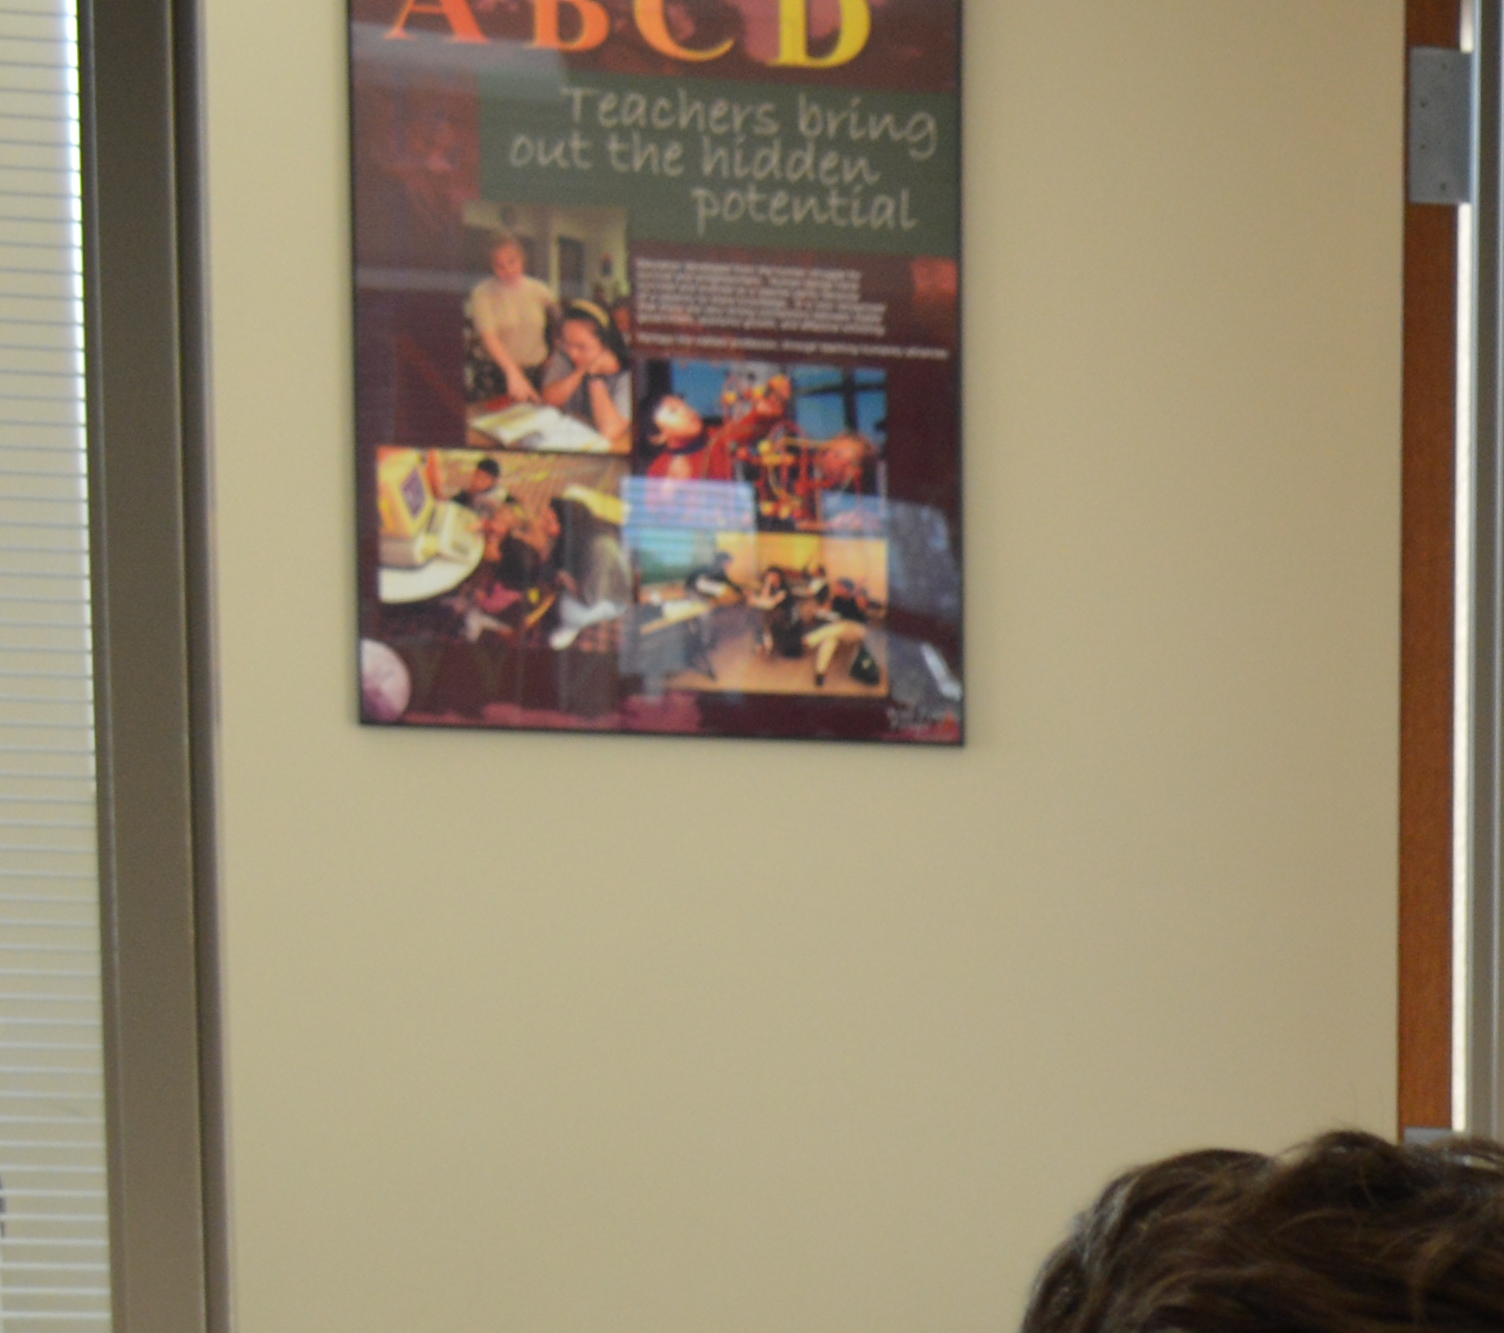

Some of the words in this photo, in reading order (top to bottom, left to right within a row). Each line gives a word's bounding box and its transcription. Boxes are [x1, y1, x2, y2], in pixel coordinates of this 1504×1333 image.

[560, 85, 781, 135] Teachers
[798, 95, 938, 160] bring
[508, 128, 592, 170] out
[607, 126, 685, 178] the
[700, 133, 880, 186] hidden
[692, 184, 918, 238] potential
